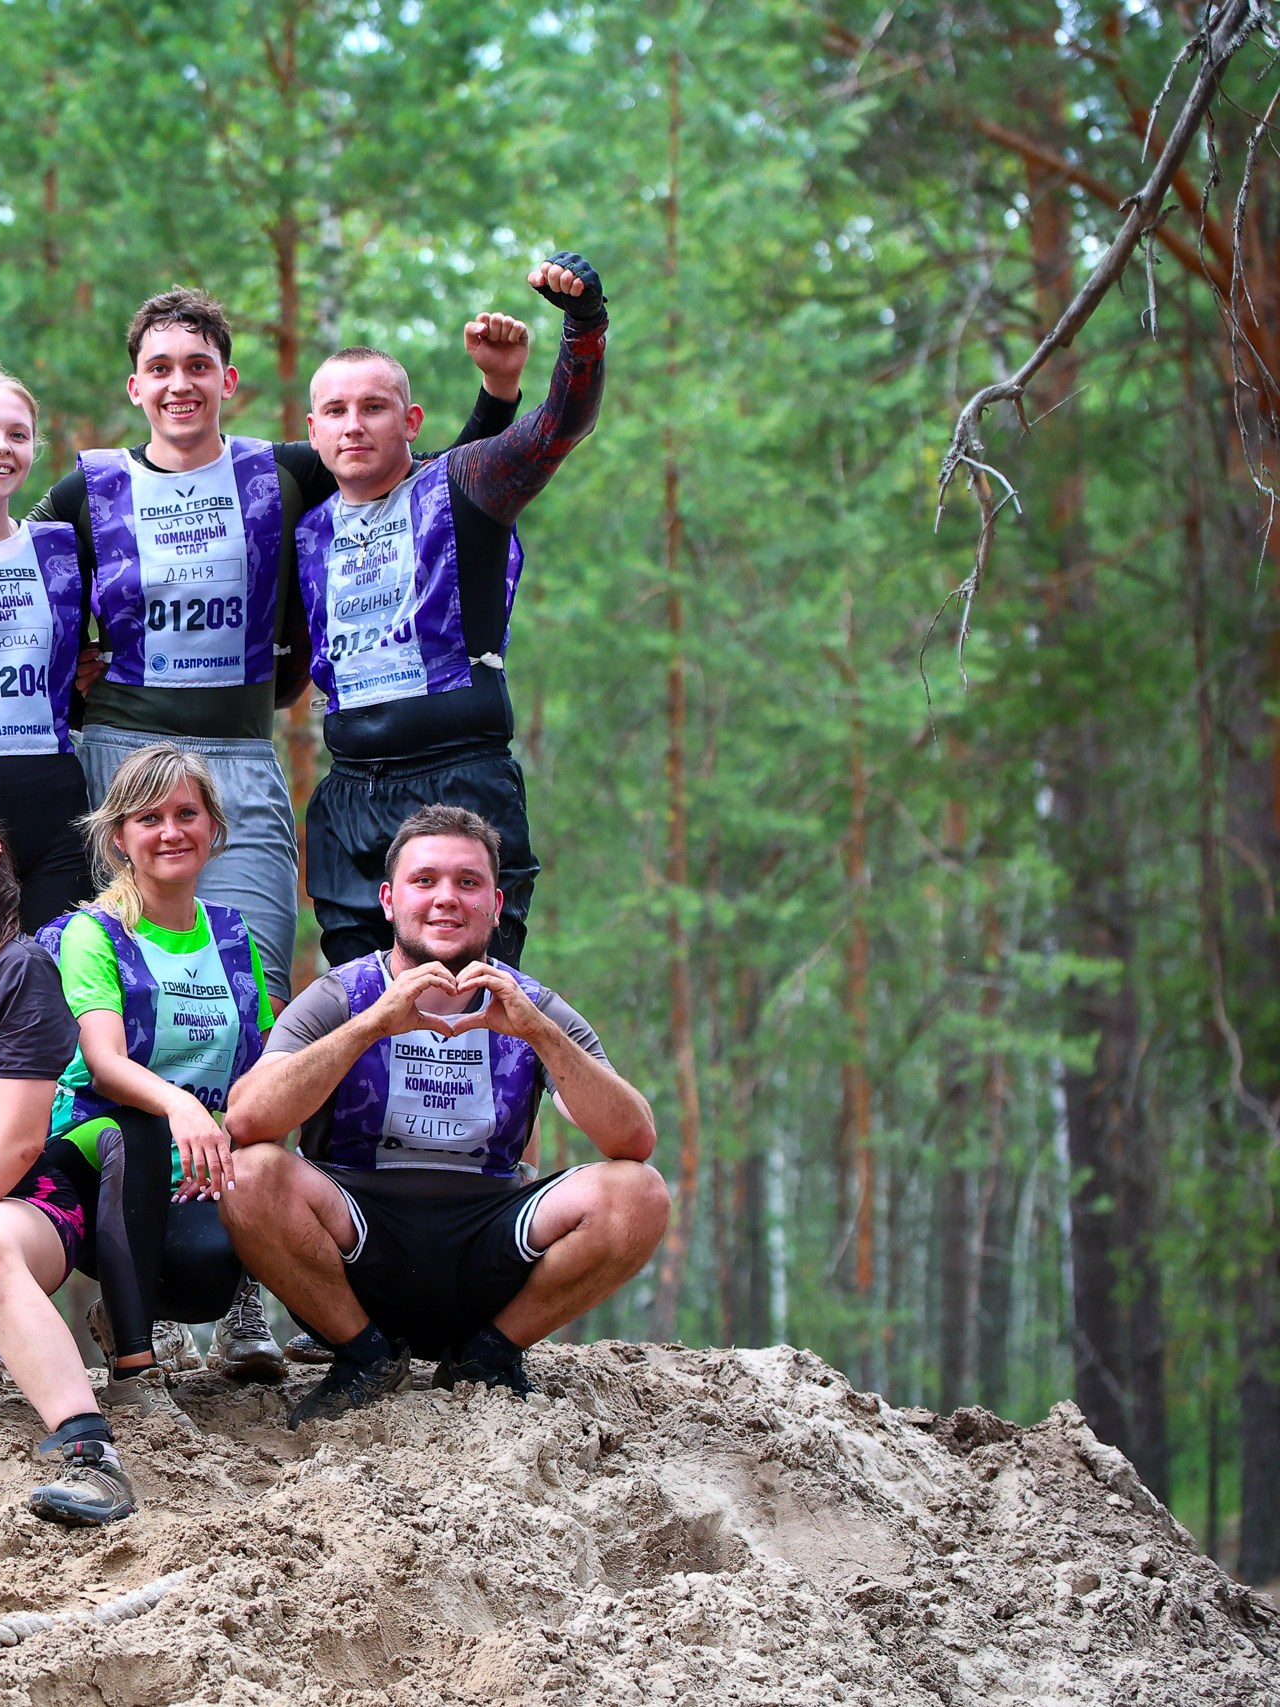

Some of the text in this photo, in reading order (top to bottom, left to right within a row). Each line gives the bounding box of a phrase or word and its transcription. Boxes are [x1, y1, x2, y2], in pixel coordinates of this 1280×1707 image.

[140, 496, 234, 517] ГОНКА ГЕРОЕВ
[158, 512, 225, 531] ШТОРМ
[154, 522, 227, 545] КОМАНДНЫЙ
[176, 542, 209, 556] СТАРТ
[163, 565, 214, 584] ДАНЯ
[356, 568, 381, 586] СТАРТ
[148, 596, 243, 632] 01203
[173, 655, 241, 669] ГАЗПРОМБАНК
[162, 981, 228, 996] ГОНКА ГЕРОЕВ
[173, 1011, 228, 1027] КОМАНДНЫЙ
[188, 1028, 215, 1042] СТАРТ
[395, 1043, 483, 1060] ГОНКА ГЕРОЕВ
[406, 1062, 468, 1079] ШТОРМ
[405, 1077, 474, 1096] КОМАНДНЫЙ
[423, 1095, 457, 1110] СТАРТ
